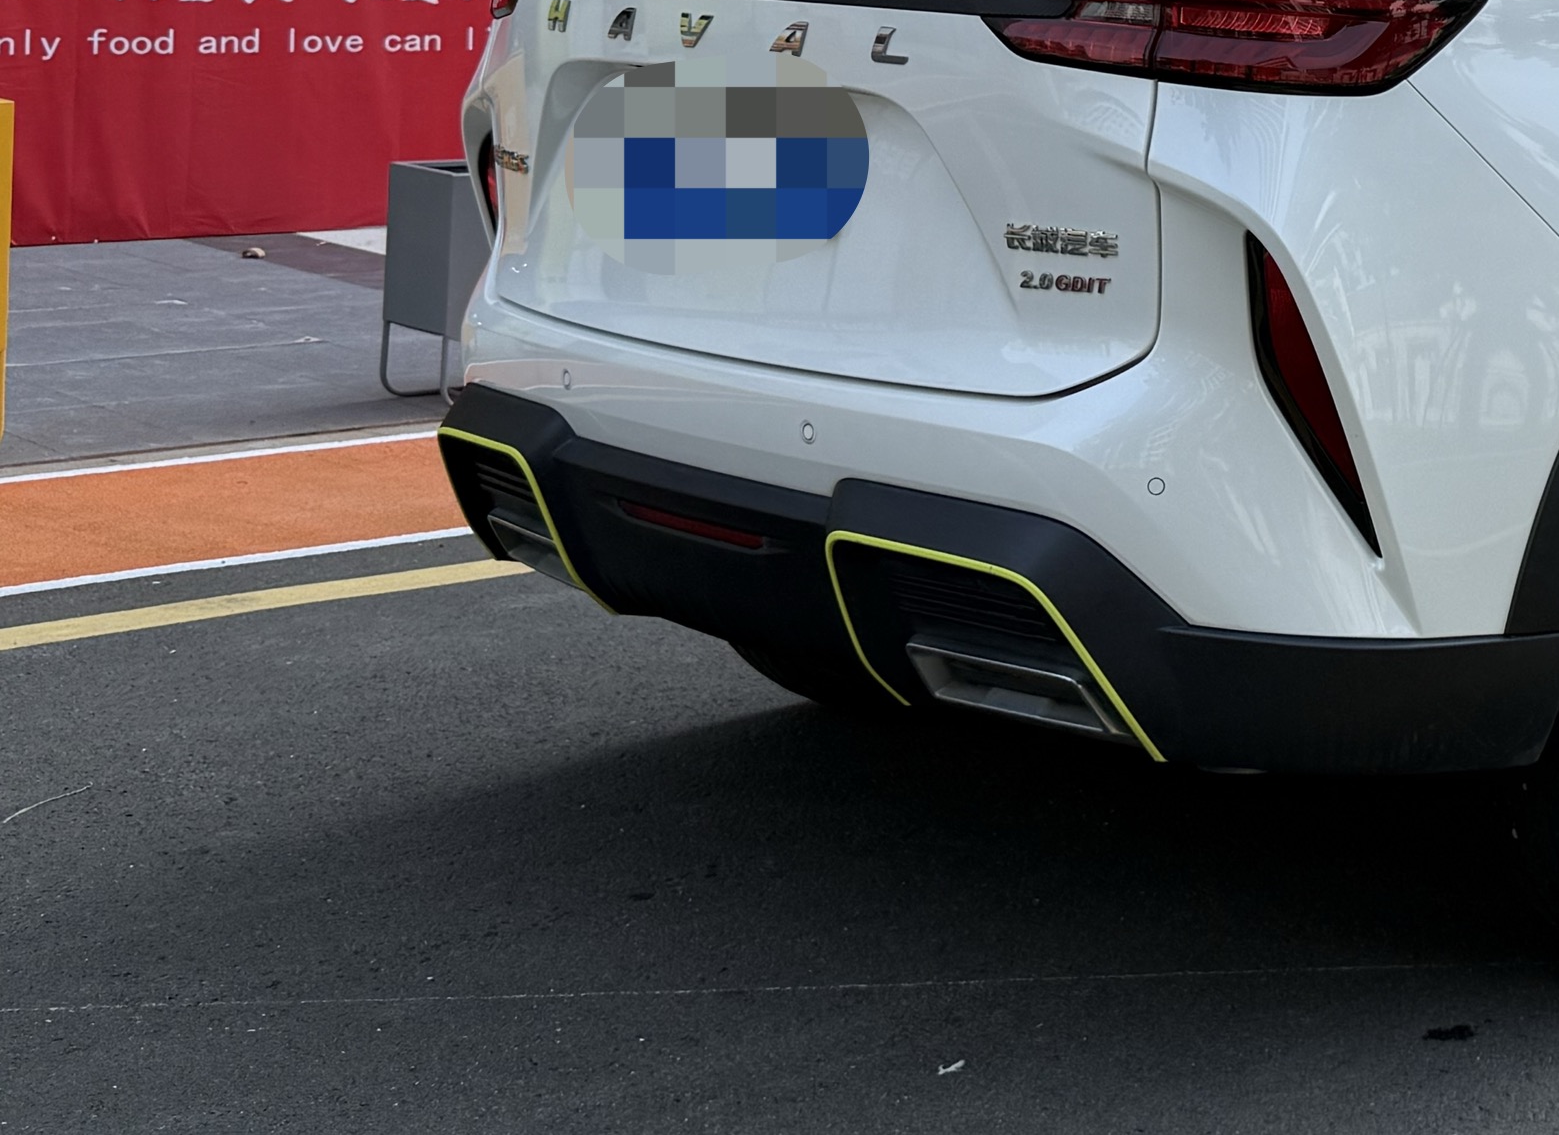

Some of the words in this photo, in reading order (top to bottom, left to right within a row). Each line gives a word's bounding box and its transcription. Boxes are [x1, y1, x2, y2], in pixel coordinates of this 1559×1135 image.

[87, 28, 175, 55] food
[199, 28, 260, 53] and
[289, 27, 363, 53] love
[384, 33, 442, 52] can
[1004, 223, 1119, 258] 长城汽车
